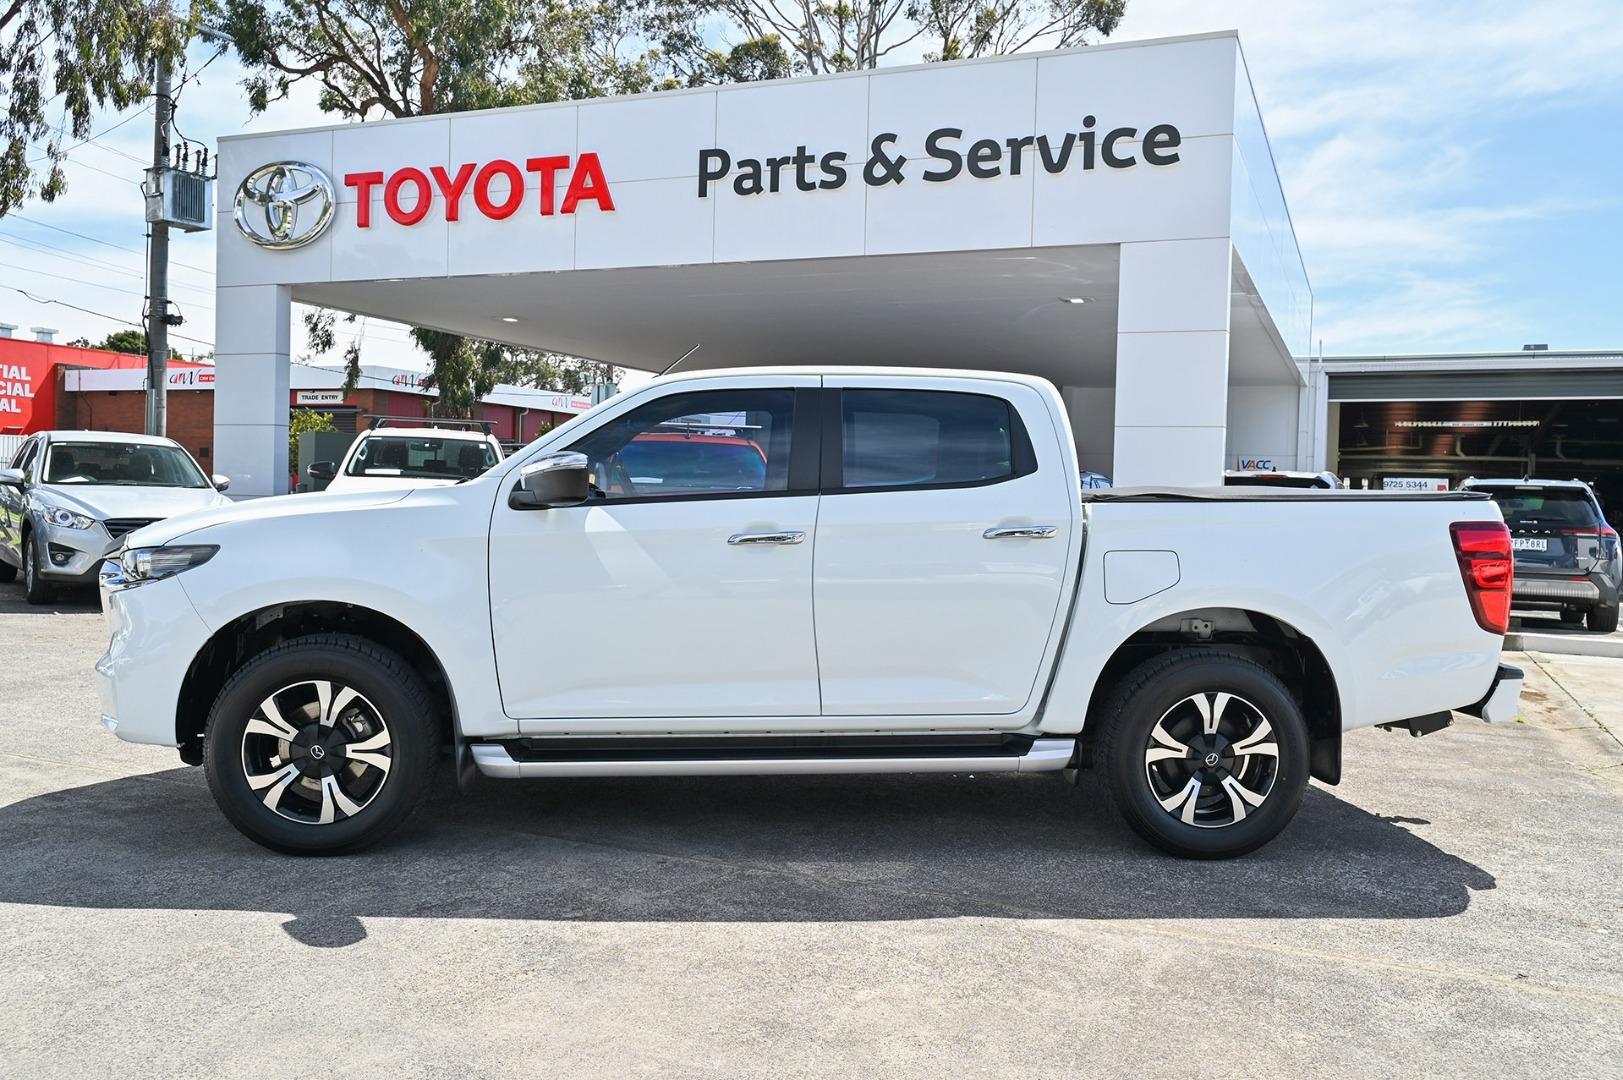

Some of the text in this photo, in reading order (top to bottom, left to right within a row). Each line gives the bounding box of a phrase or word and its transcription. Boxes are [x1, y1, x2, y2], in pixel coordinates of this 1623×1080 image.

[698, 114, 1182, 198] Parts & Service
[344, 152, 616, 229] TOYOTA
[0, 364, 31, 380] IAL
[1241, 459, 1271, 470] VACC
[1383, 480, 1428, 489] 9725 5344
